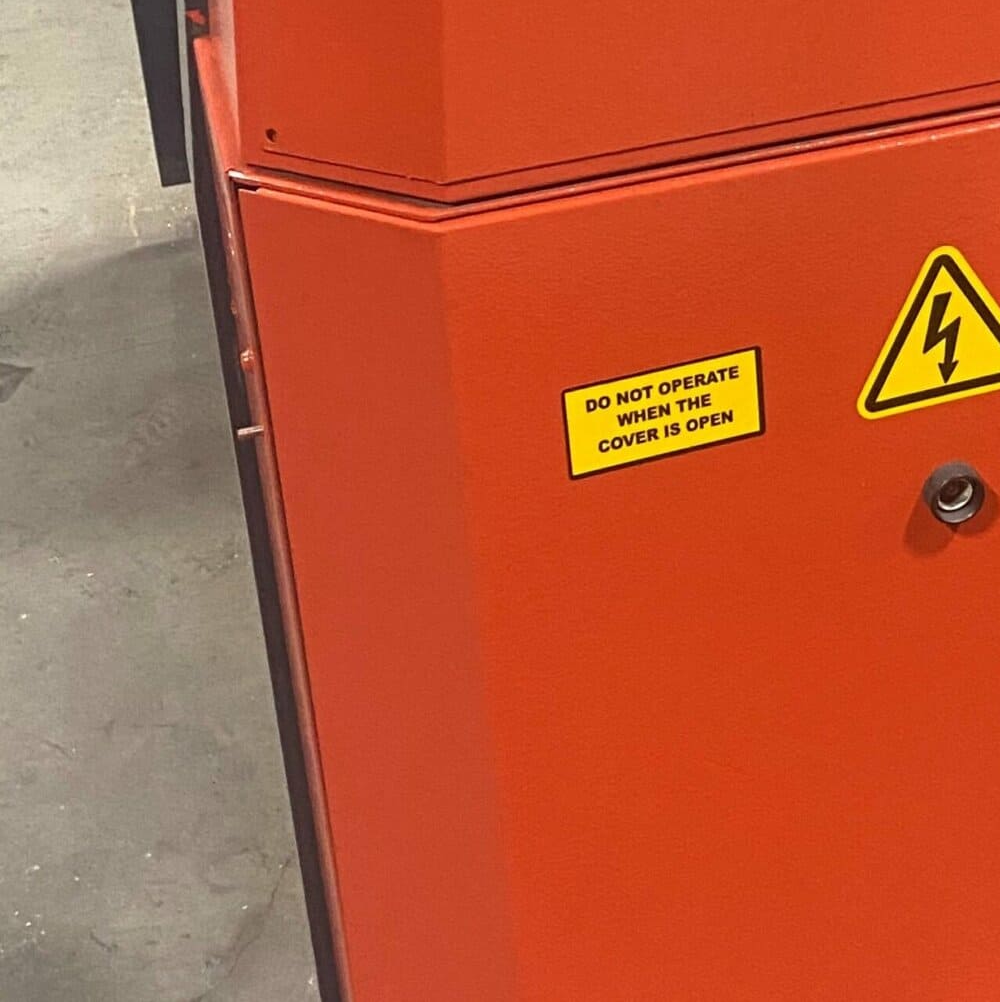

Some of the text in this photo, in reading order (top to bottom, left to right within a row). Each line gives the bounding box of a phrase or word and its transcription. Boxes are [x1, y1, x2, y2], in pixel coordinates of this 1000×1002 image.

[585, 365, 739, 413] DO NOT OPERATE
[617, 393, 711, 427] WHEN THE
[598, 410, 734, 453] COVER IS OPEN
